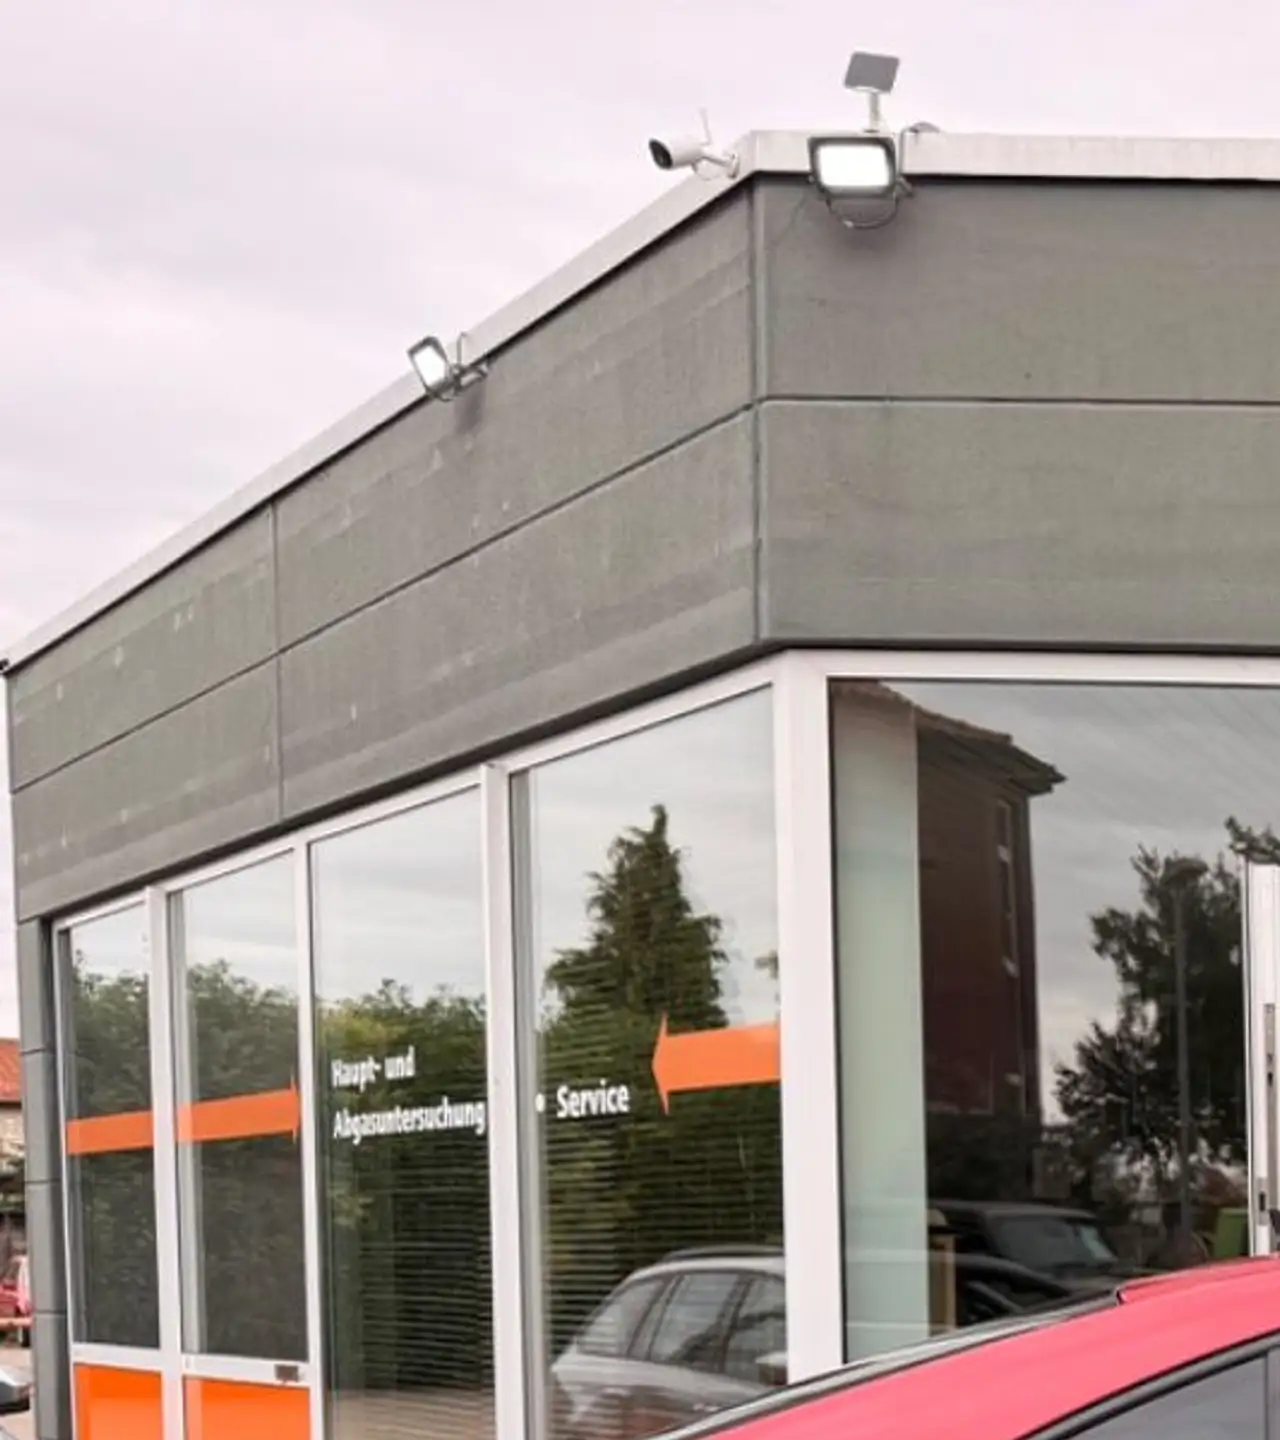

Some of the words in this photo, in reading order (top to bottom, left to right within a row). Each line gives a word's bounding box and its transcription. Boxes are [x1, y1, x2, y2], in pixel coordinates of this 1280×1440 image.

[331, 1055, 382, 1093] Haupt-
[384, 1044, 416, 1080] und
[333, 1095, 486, 1146] Abgasuntersuchung
[555, 1077, 631, 1118] Service
